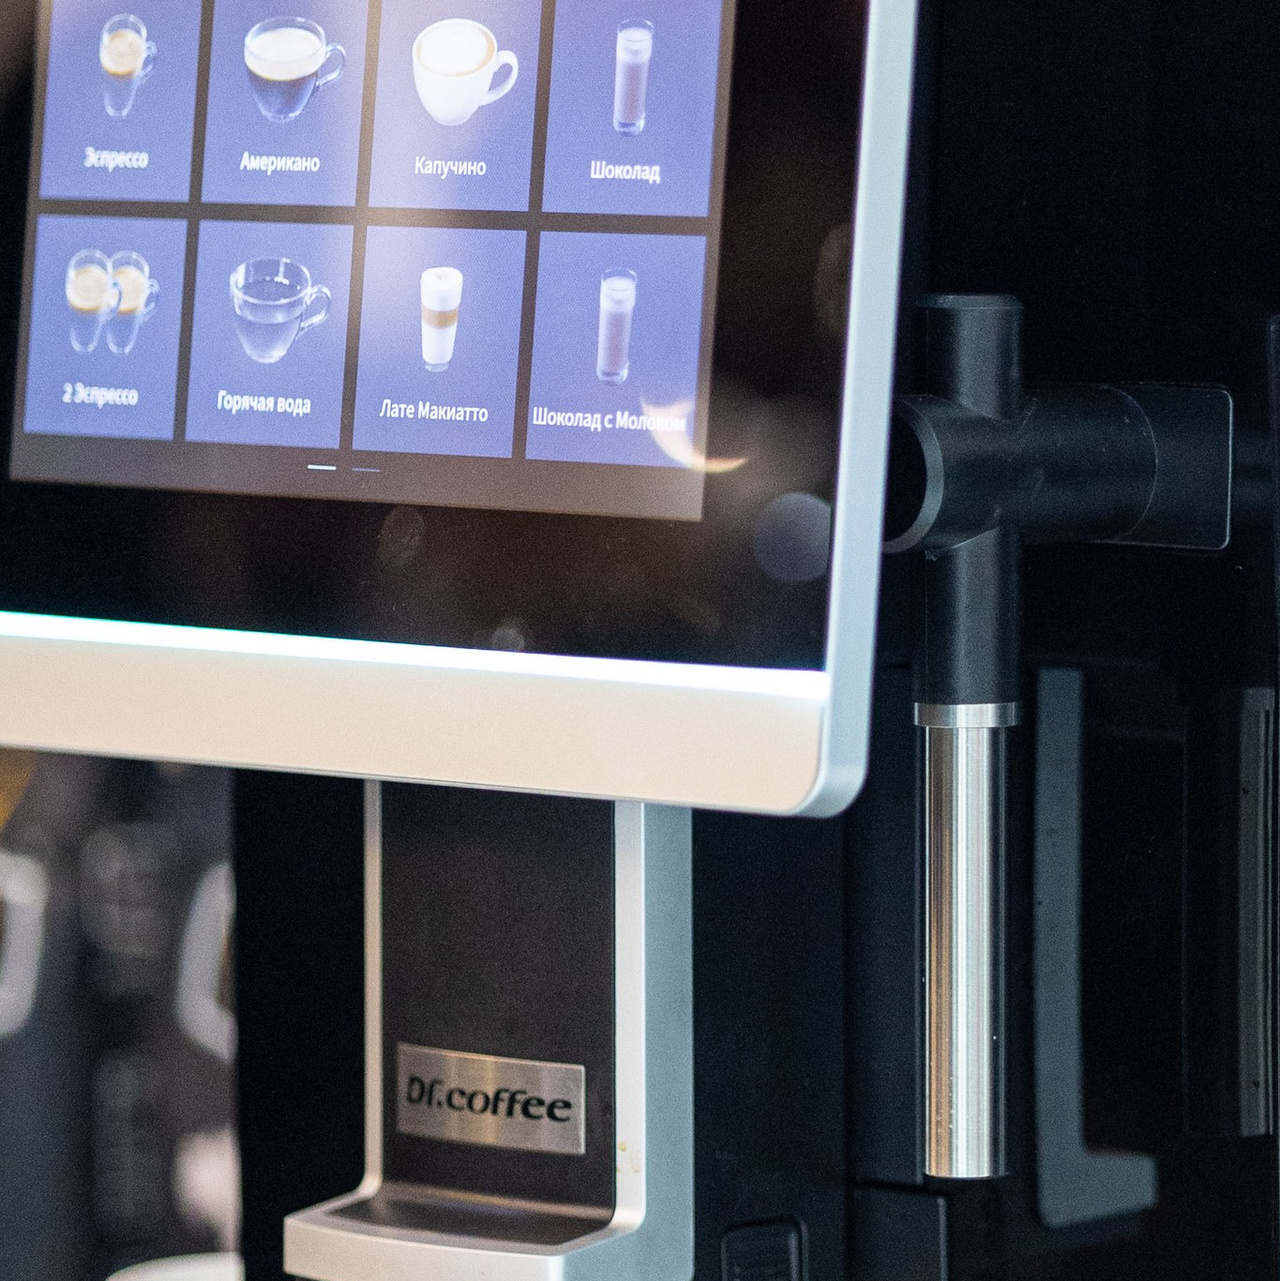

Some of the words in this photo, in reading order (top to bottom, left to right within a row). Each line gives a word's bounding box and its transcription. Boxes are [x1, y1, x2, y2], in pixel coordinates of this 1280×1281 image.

[84, 146, 149, 173] Эспрессо
[239, 151, 320, 176] Американо
[415, 156, 487, 180] Капучино
[590, 160, 661, 185] Шоколад
[62, 382, 73, 403] 2
[74, 382, 139, 410] Эспрессо
[217, 389, 274, 415] Горячая
[277, 396, 312, 417] вода
[379, 398, 415, 419] Лате
[418, 400, 489, 422] Макиатто
[532, 406, 602, 432] Шоколад
[604, 413, 613, 429] с
[615, 410, 687, 432] Молоком
[406, 1074, 573, 1123] Dr.coffee
